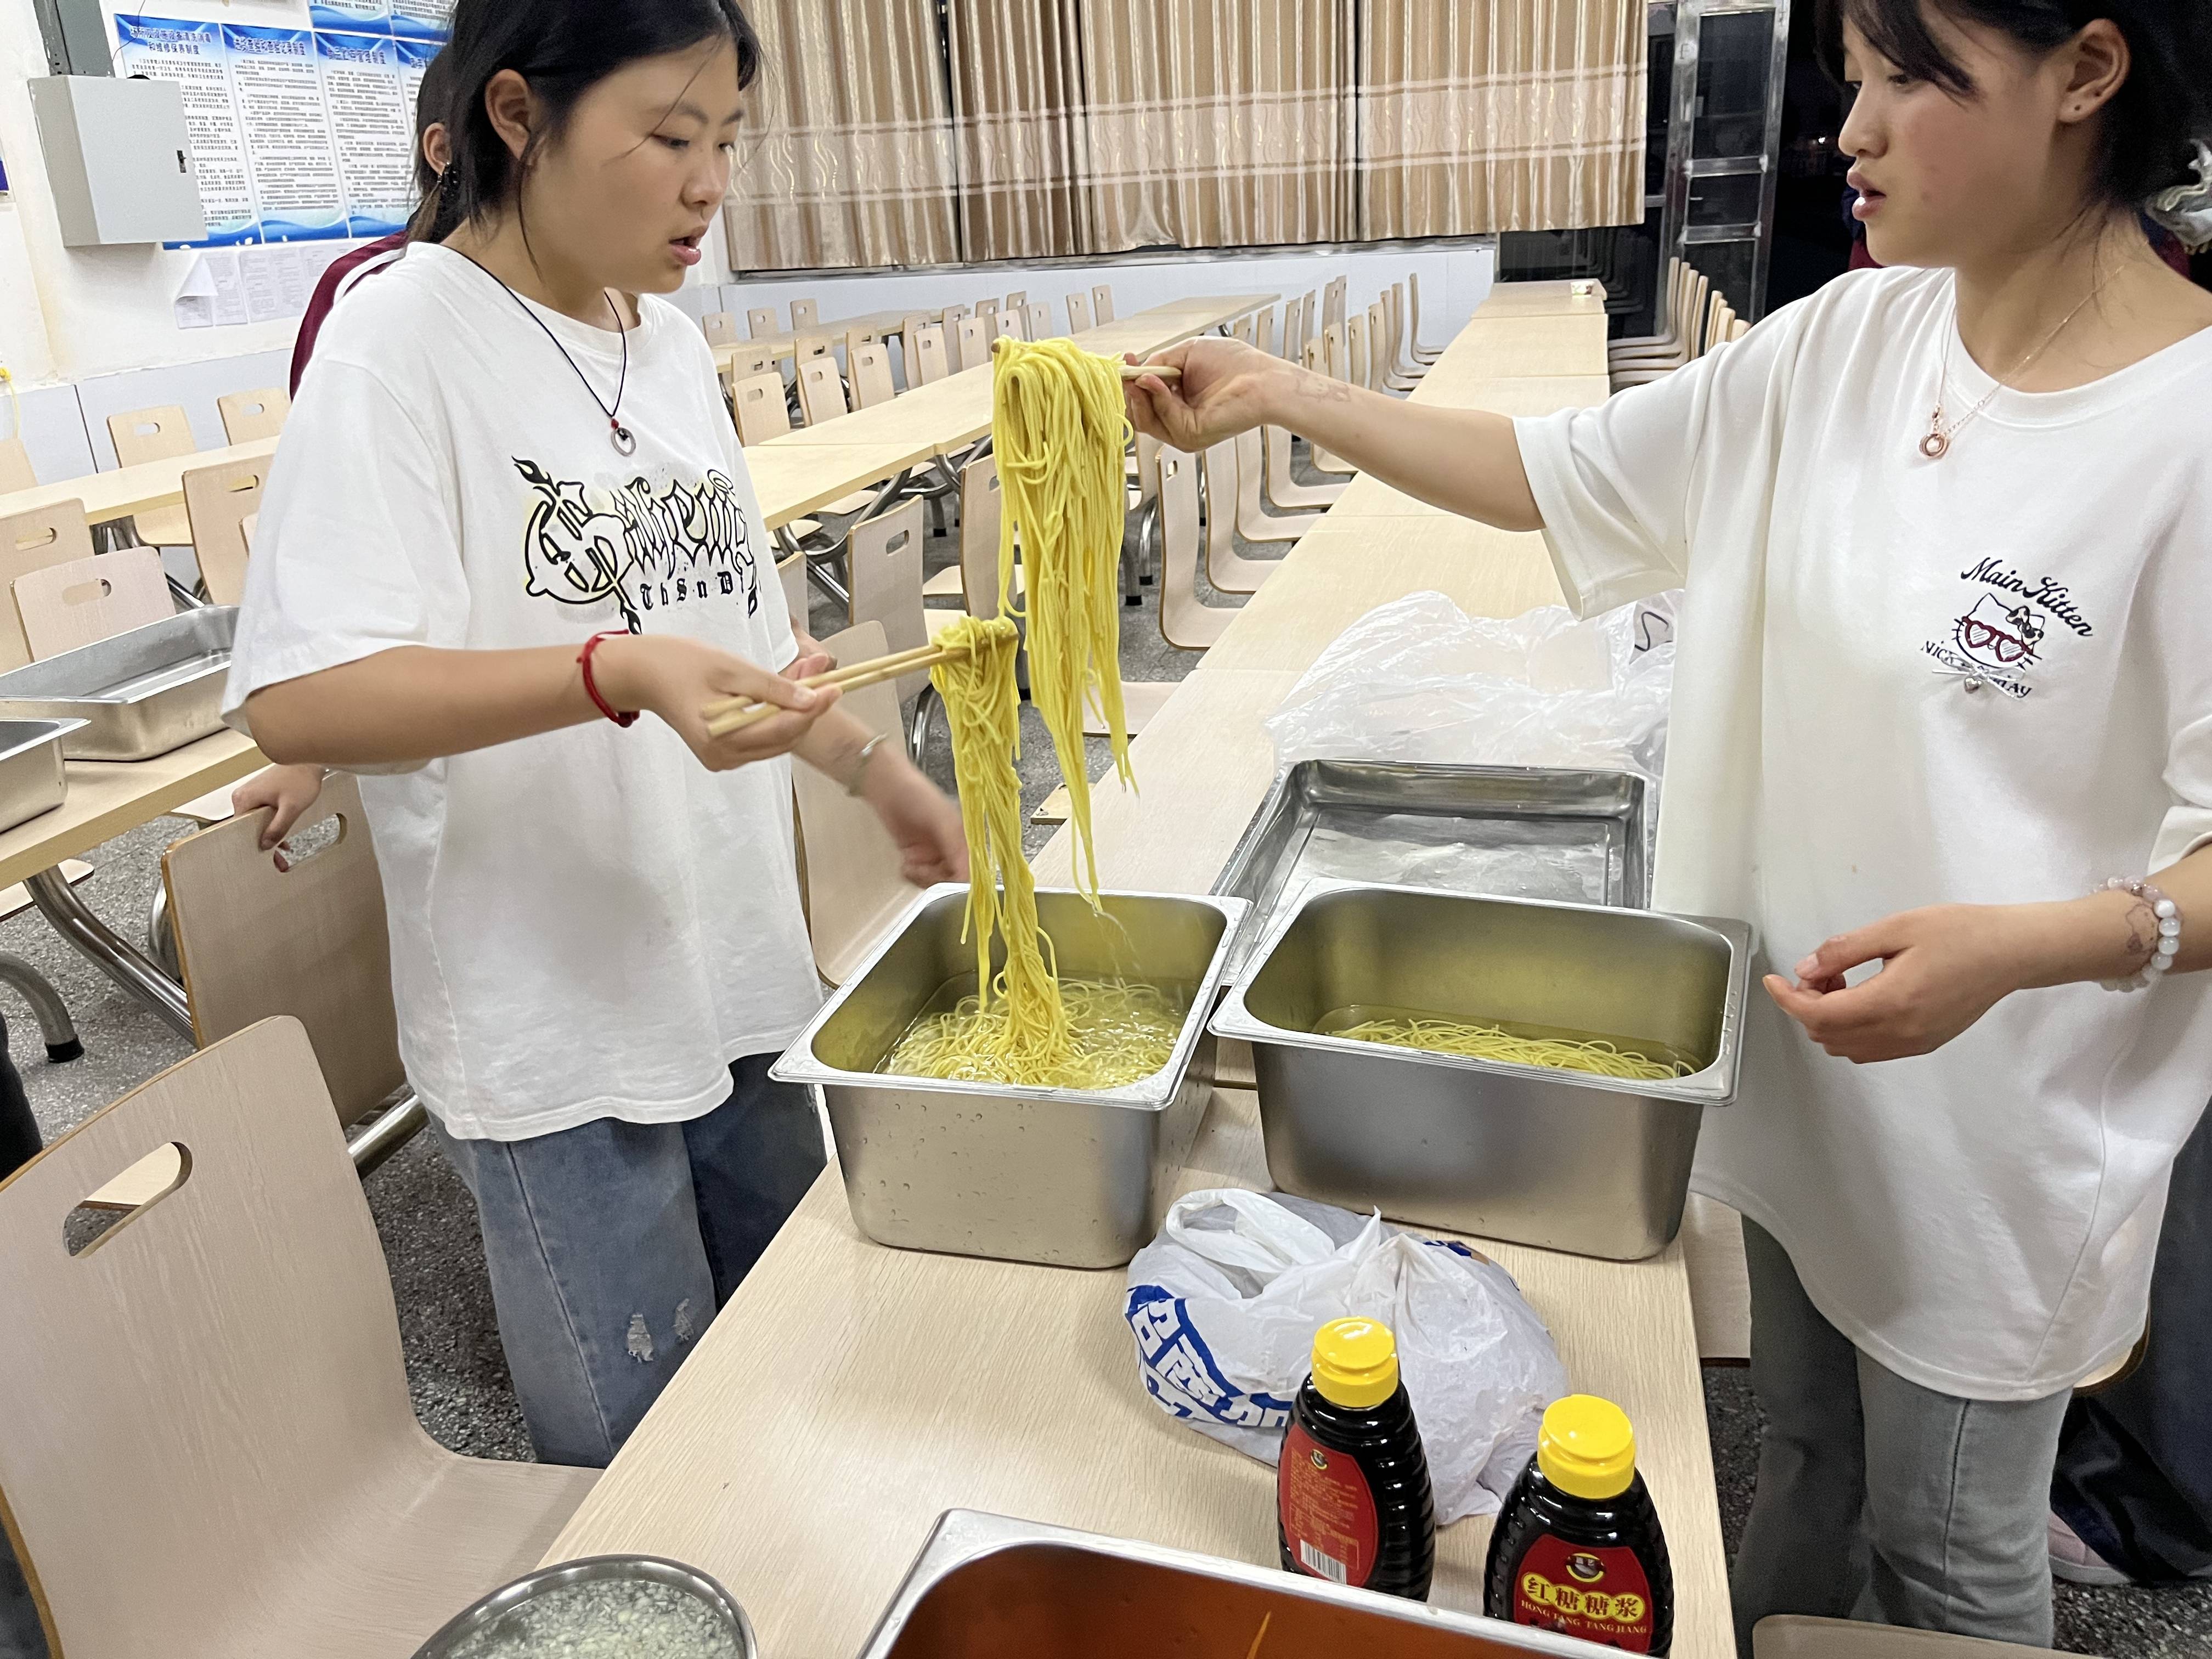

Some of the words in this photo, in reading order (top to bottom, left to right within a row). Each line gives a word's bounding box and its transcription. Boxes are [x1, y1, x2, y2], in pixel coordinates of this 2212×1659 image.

[1960, 556, 2027, 592] Main
[2022, 576, 2094, 637] Kitten
[1521, 1599, 1550, 1617] HONG
[1553, 1613, 1581, 1627] TANG
[1586, 1620, 1615, 1632] TANG
[1616, 1624, 1647, 1634] JIANG
[1527, 1576, 1639, 1618] 红糖糖浆
